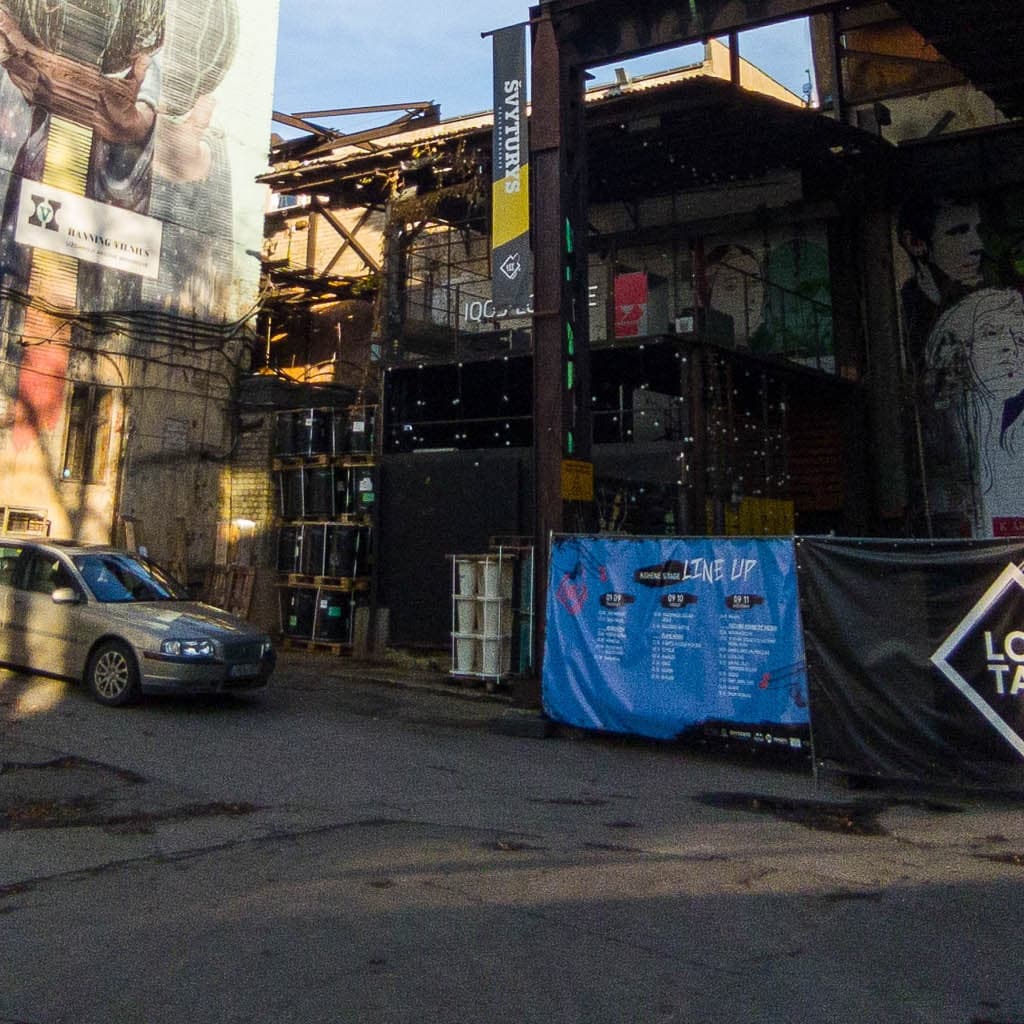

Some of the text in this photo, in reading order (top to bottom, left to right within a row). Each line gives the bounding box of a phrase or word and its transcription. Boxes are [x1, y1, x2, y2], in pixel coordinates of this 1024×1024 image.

[504, 80, 522, 194] ŠVYTURYS
[67, 227, 112, 248] HANNING
[112, 239, 152, 257] VILNIUS
[464, 299, 508, 322] IQO
[681, 557, 725, 584] LINE
[731, 558, 758, 582] UP
